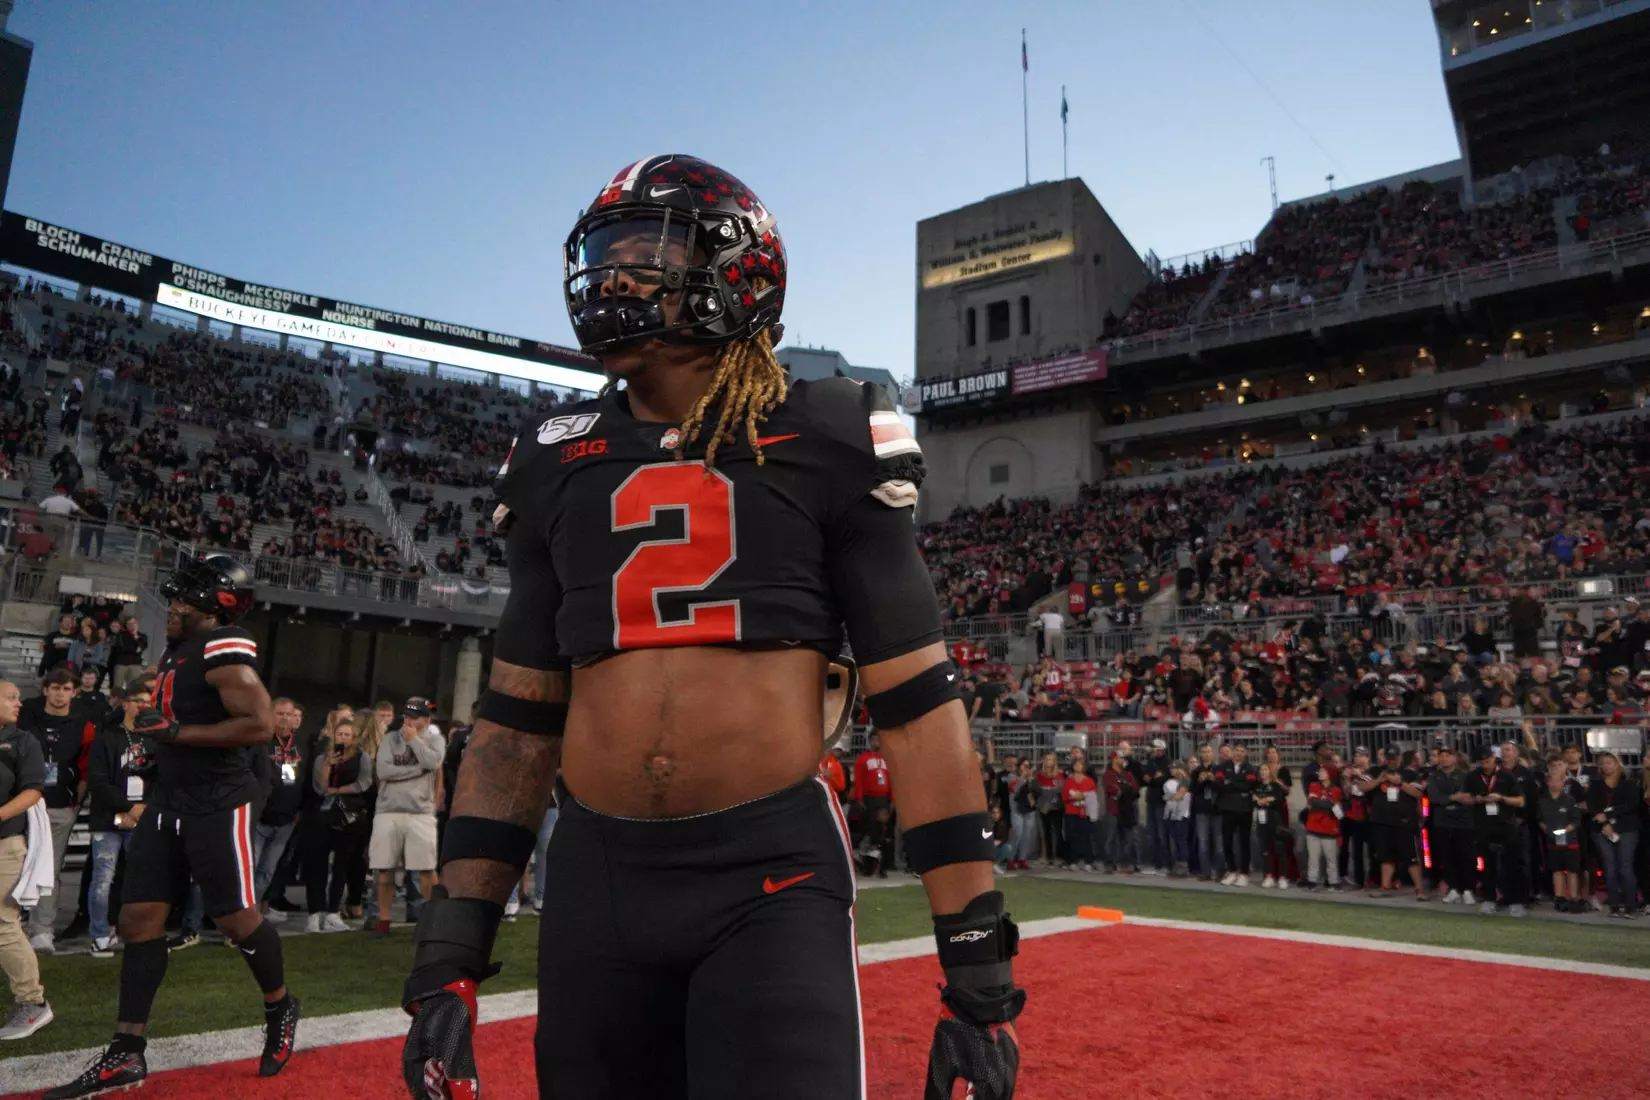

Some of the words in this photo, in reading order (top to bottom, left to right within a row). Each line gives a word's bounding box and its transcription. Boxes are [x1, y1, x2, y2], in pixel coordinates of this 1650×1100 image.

[25, 218, 80, 244] BLOCH
[101, 242, 153, 267] CRANE
[37, 235, 140, 275] SCHUMAKER
[172, 262, 227, 288] PHIPPS
[960, 260, 997, 277] Stadium
[1001, 252, 1032, 267] Center
[174, 275, 292, 312] O'SHAUGHNESSY
[189, 296, 267, 326] BUCKEYE
[322, 310, 376, 330] NOURSE
[335, 302, 420, 328] HUNTINGTON
[424, 320, 484, 341] NATIONAL
[487, 333, 521, 348] BANK
[922, 381, 955, 401] PAUL
[958, 372, 1007, 394] BROWN
[537, 412, 601, 445] 150
[611, 460, 742, 650] 2
